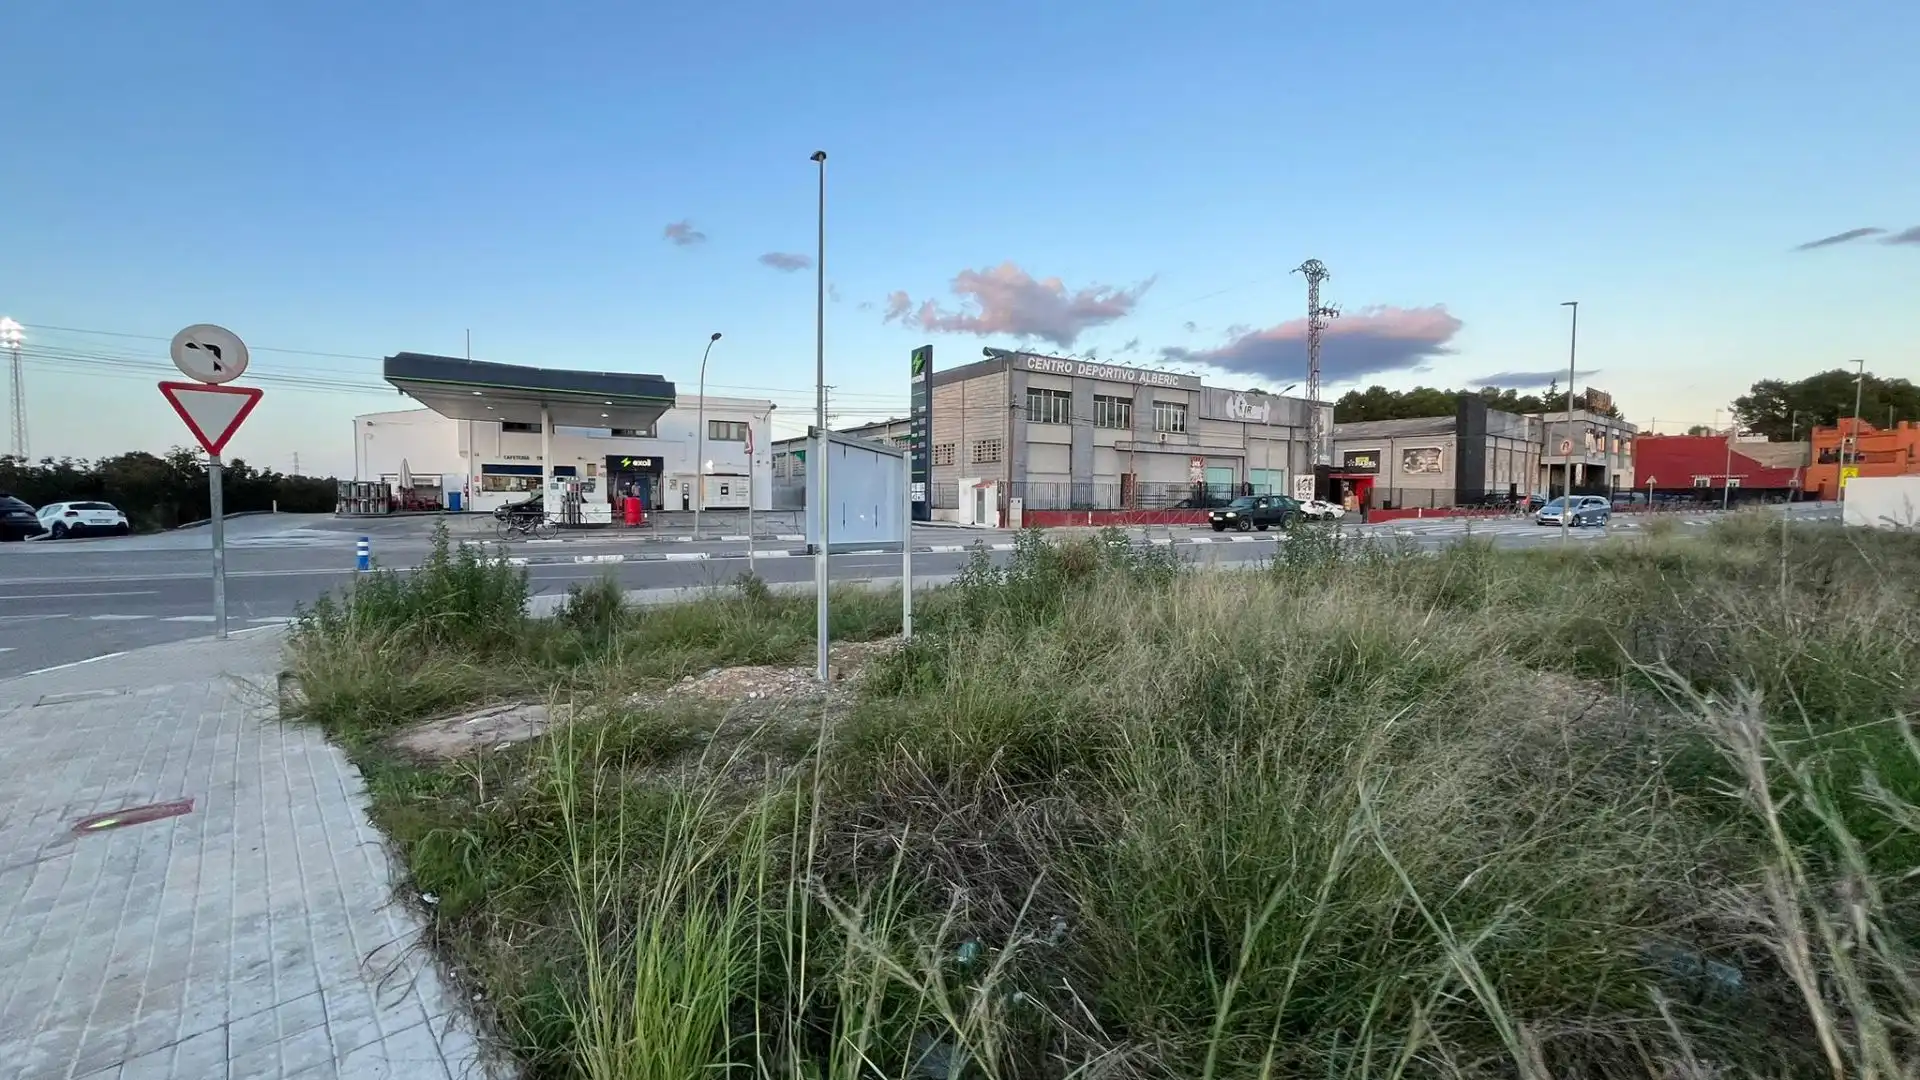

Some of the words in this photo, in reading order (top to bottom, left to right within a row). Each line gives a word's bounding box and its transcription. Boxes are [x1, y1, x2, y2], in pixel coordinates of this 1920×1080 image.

[1027, 356, 1073, 373] CENTRO
[1077, 363, 1135, 381] DEPORTIVO
[1139, 372, 1179, 386] ALBERIC
[632, 458, 652, 467] exoil
